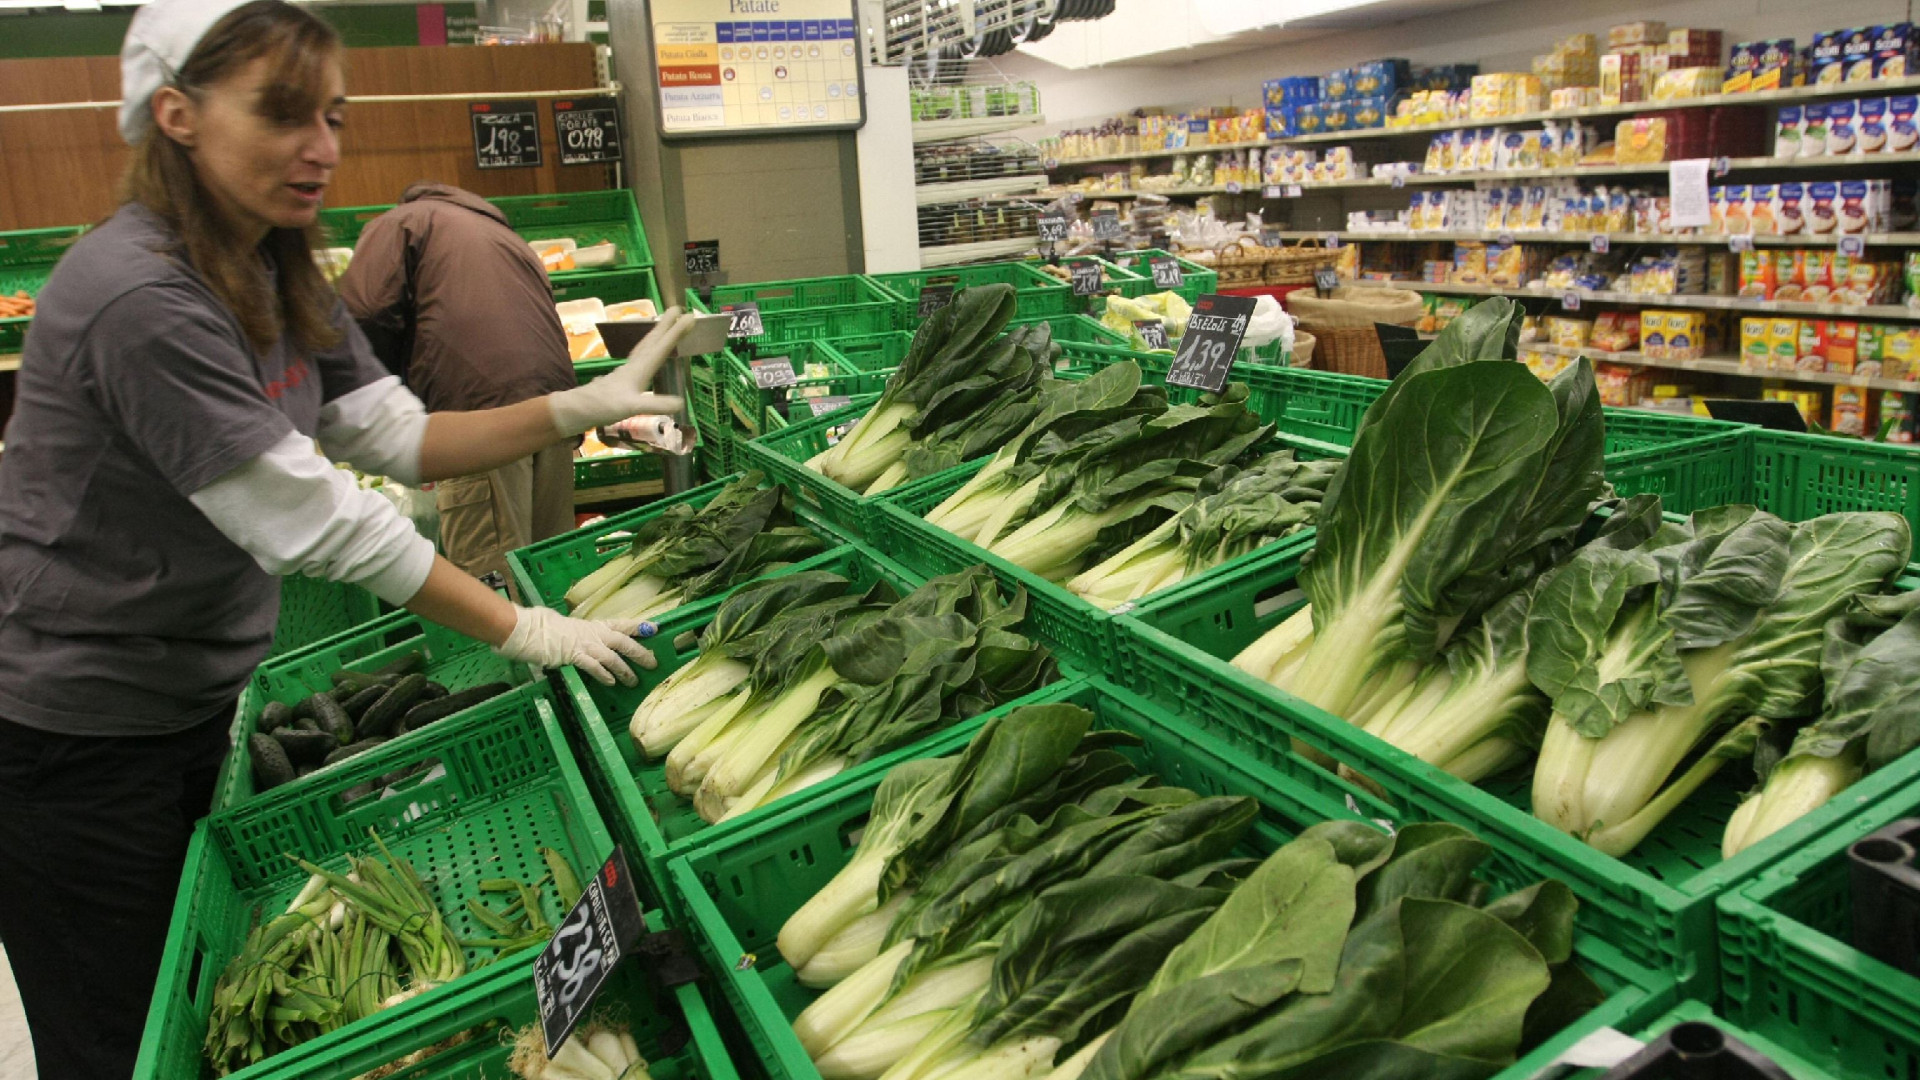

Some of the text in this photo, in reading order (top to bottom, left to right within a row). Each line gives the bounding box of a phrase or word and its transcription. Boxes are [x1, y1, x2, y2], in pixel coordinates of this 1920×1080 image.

[729, 0, 779, 14] Patate
[661, 49, 708, 59] Patata Gialla
[662, 71, 712, 81] Patata Rossa
[664, 92, 721, 101] Patata Azzurra
[667, 113, 691, 122] Patata
